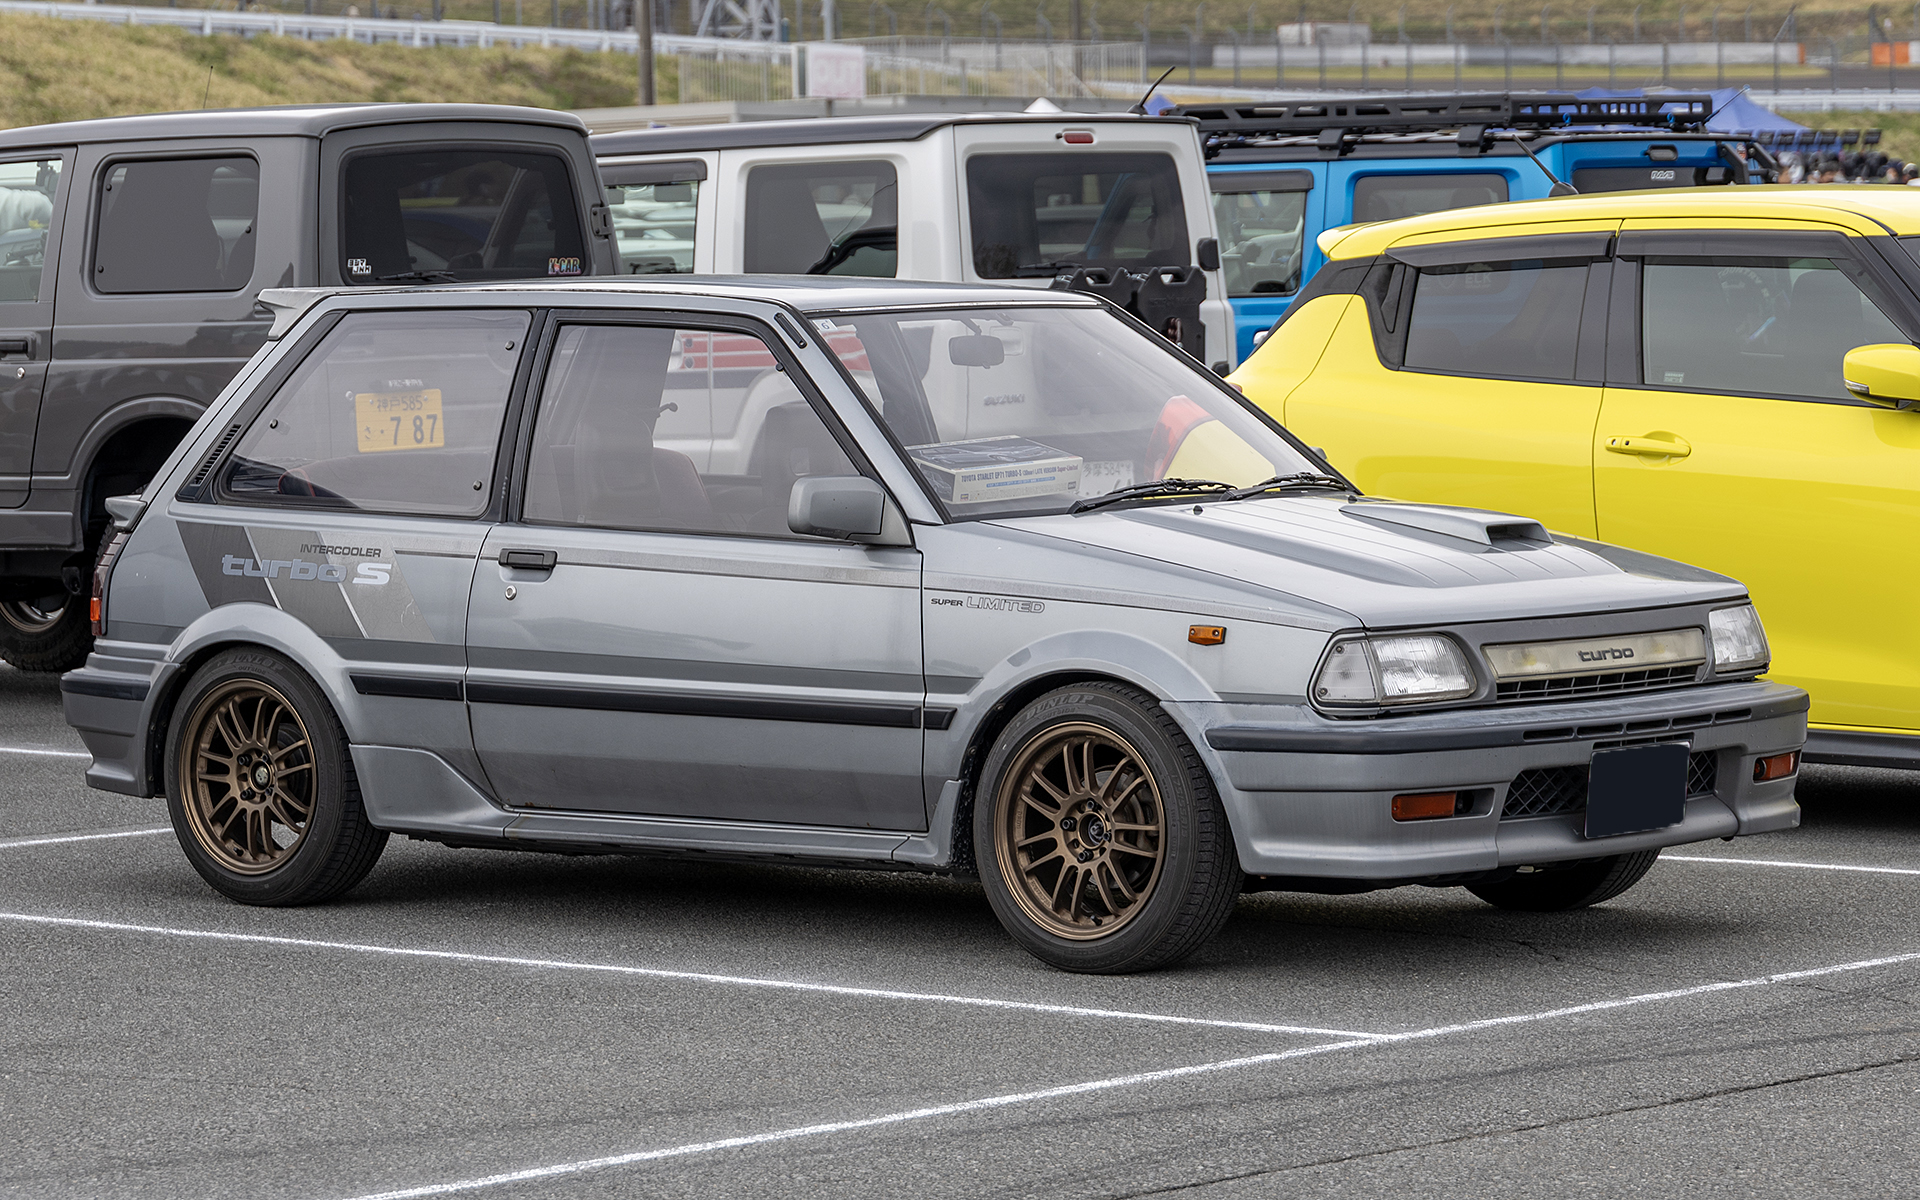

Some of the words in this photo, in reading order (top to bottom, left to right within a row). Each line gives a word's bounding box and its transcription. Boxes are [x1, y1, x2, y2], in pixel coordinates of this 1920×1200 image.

[983, 394, 1024, 406] SUZUKI
[961, 473, 976, 483] TOYOTA
[300, 543, 381, 558] INTERCOOLER
[221, 554, 347, 583] turbo
[352, 562, 392, 585] S
[930, 597, 964, 607] SUPER
[966, 596, 1046, 613] LIMITED
[225, 653, 284, 671] DUNLOP
[1577, 647, 1634, 662] turbo
[1026, 694, 1095, 720] DUNLOP
